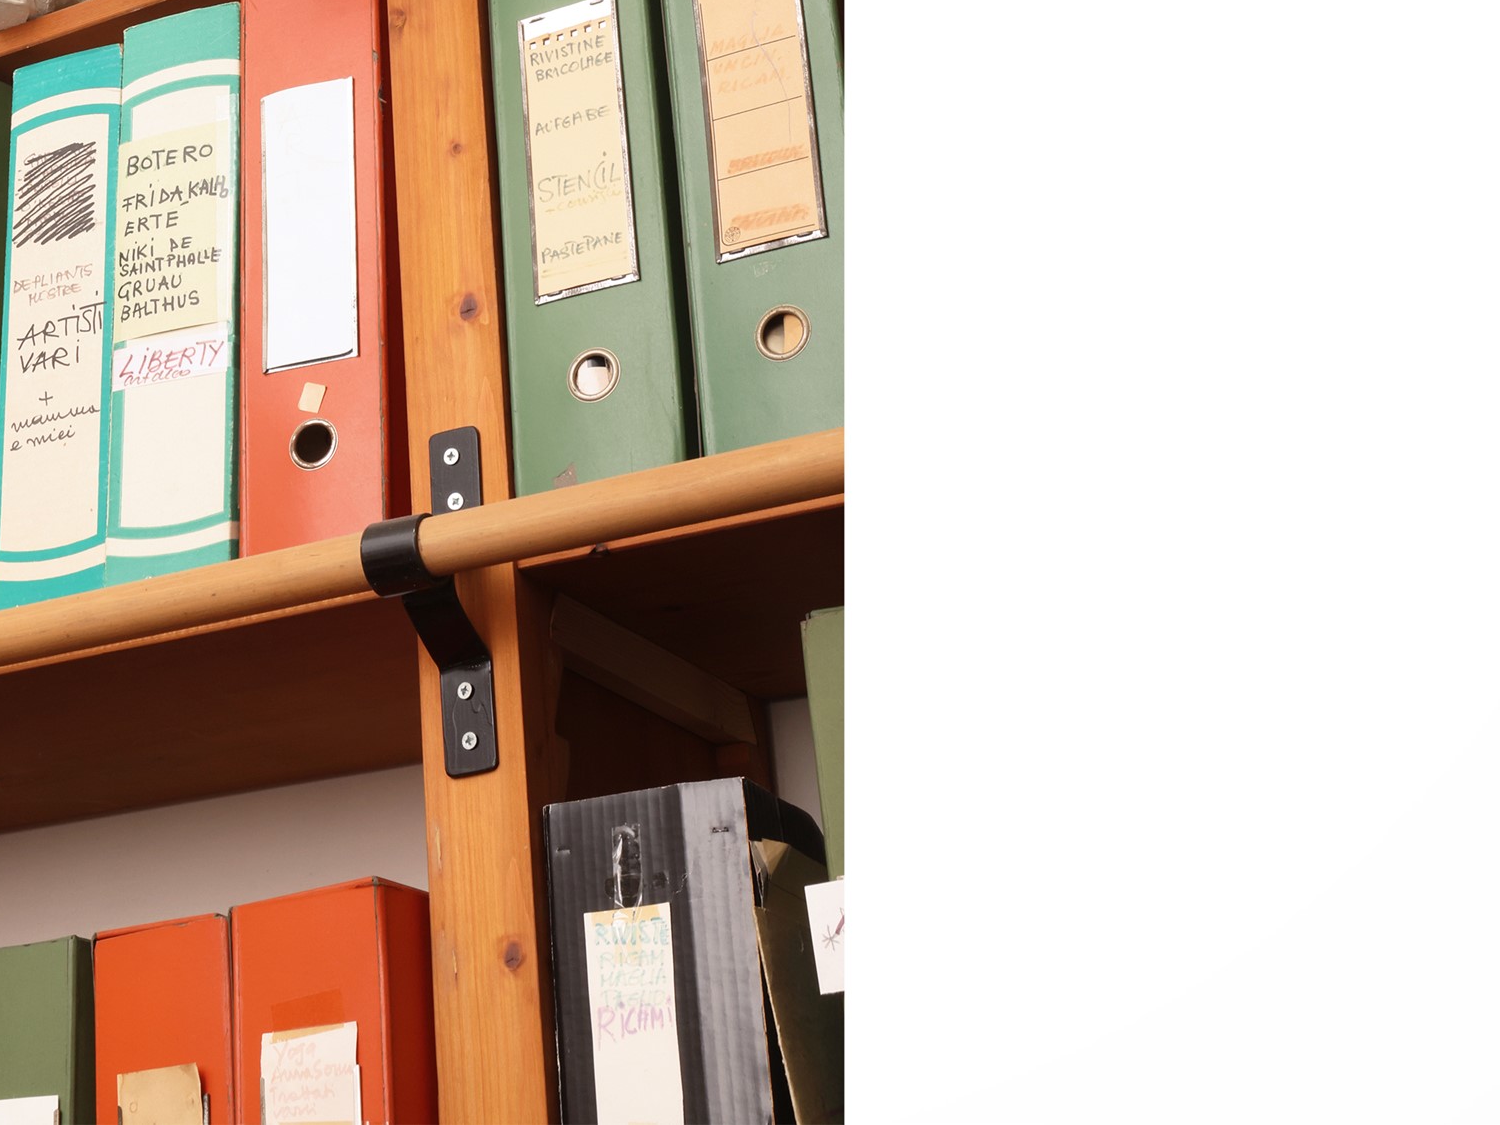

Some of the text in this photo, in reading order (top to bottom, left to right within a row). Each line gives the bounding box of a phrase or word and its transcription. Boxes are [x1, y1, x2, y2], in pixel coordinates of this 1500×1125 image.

[530, 35, 605, 66] RIVISTINE
[126, 143, 213, 176] BOTERO
[124, 210, 179, 237] ERTE
[170, 236, 192, 252] DE
[118, 273, 183, 302] GRUAU
[16, 292, 107, 350] ARTISTI
[120, 290, 200, 323] BALTHUS
[20, 340, 80, 373] VARI
[119, 340, 224, 378] LIBERTY
